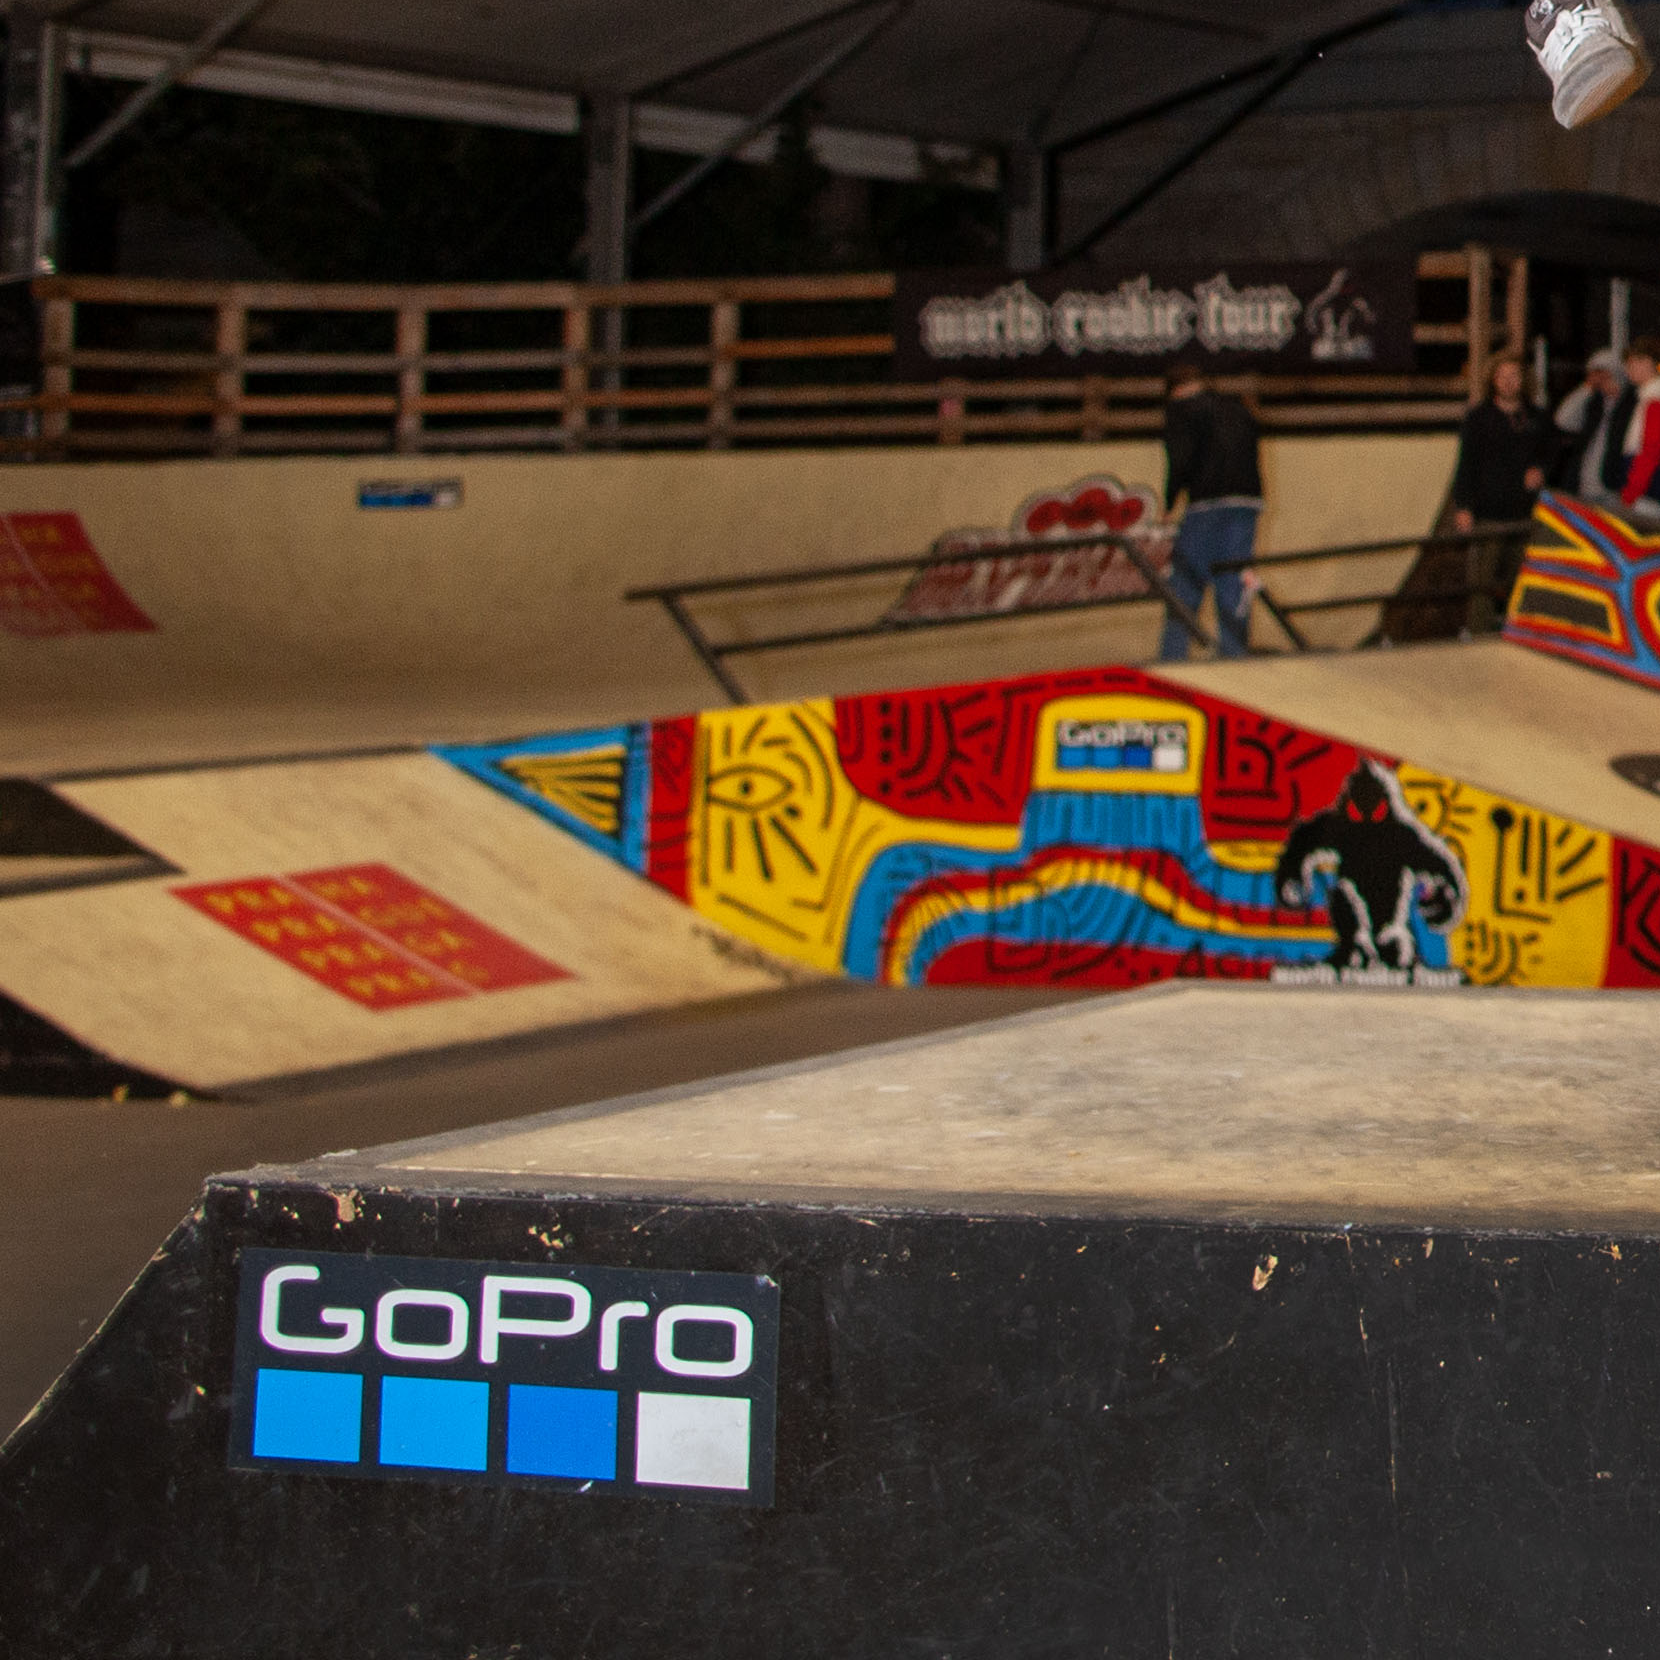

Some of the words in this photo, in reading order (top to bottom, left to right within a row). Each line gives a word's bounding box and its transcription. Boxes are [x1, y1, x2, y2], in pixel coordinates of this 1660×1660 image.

[1053, 275, 1198, 356] rookie
[1195, 271, 1302, 352] tour
[1058, 719, 1187, 747] GoPro
[259, 1265, 755, 1378] GoPro
